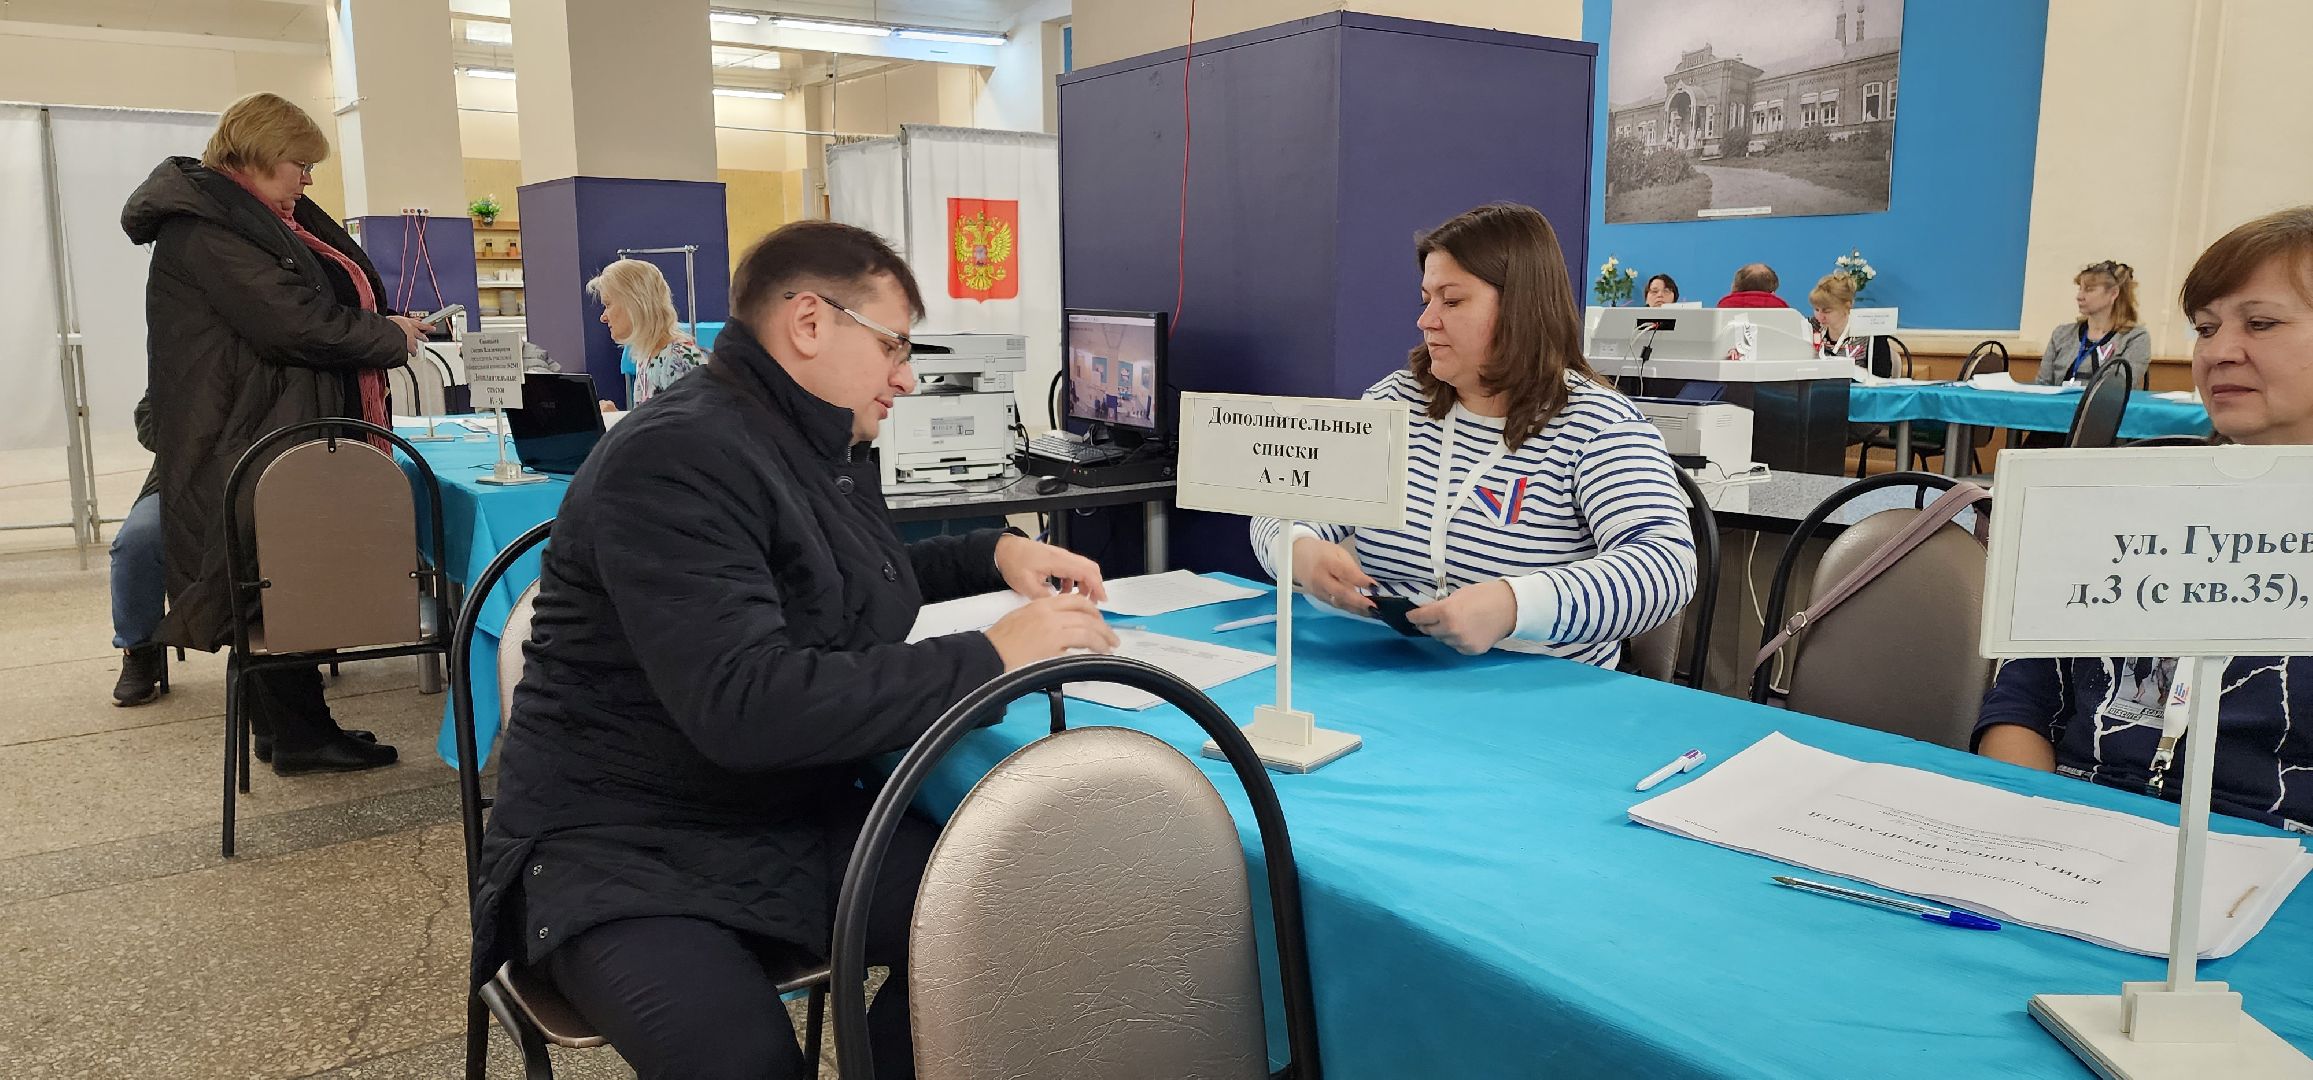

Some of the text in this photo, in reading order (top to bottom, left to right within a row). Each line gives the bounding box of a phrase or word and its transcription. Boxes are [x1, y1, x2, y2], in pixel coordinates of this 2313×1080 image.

[1208, 406, 1373, 435] Дополнительные
[1252, 441, 1319, 460] списки
[1259, 466, 1272, 484] А
[1290, 468, 1311, 488] М
[2111, 533, 2168, 564] ул.
[2066, 573, 2309, 612] д.3 (с кв.35),
[1808, 811, 1938, 849] ИЗБИРАТЕЛЕЙ
[1945, 847, 2026, 864] СПИСКА
[2034, 861, 2102, 885] КНИГА
